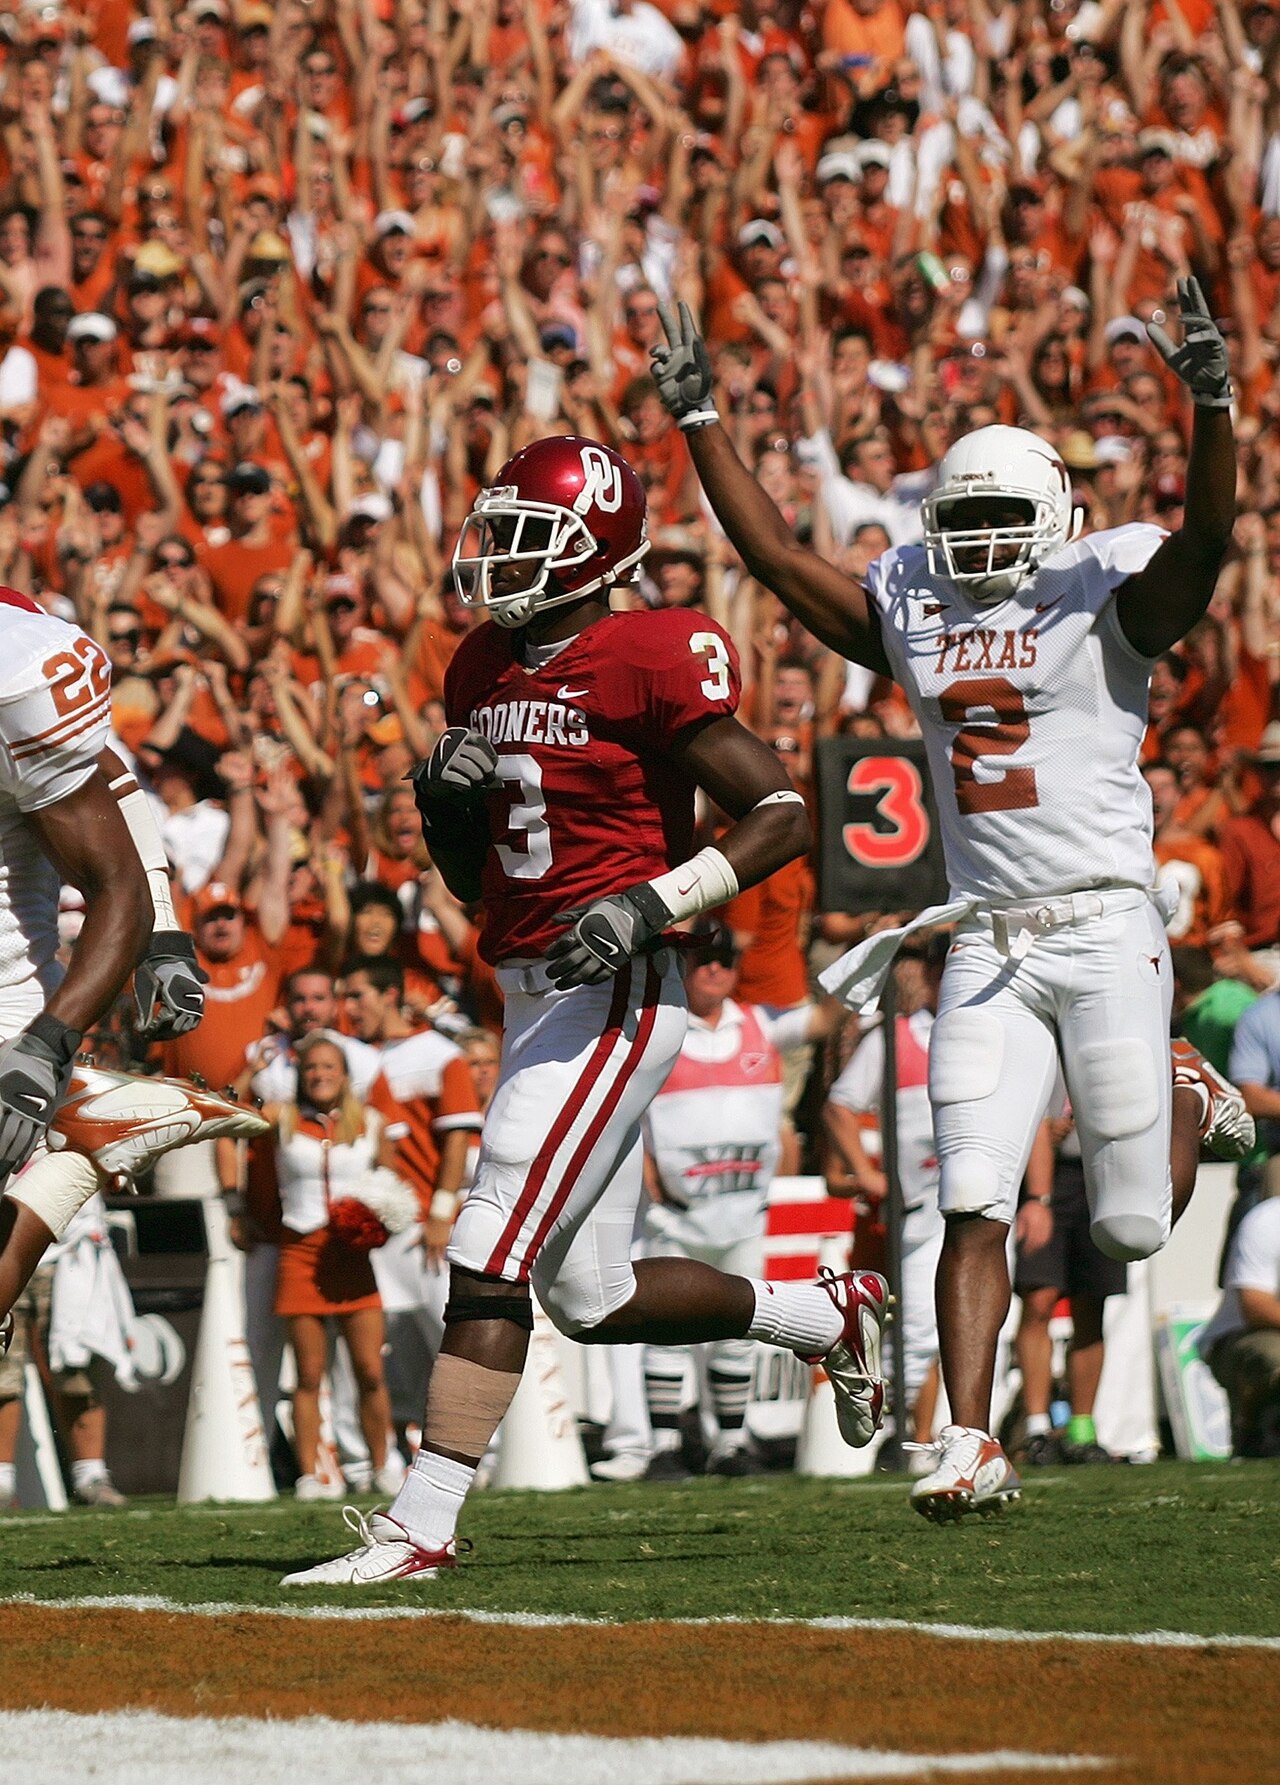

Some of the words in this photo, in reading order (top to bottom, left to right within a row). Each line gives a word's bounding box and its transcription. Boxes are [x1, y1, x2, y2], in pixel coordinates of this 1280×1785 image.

[41, 637, 111, 718] 22
[688, 631, 730, 701] 3
[934, 629, 1039, 674] TEXAS
[470, 700, 589, 746] SOONERS
[938, 676, 1039, 815] 2
[493, 754, 553, 879] 3
[843, 756, 930, 869] 3
